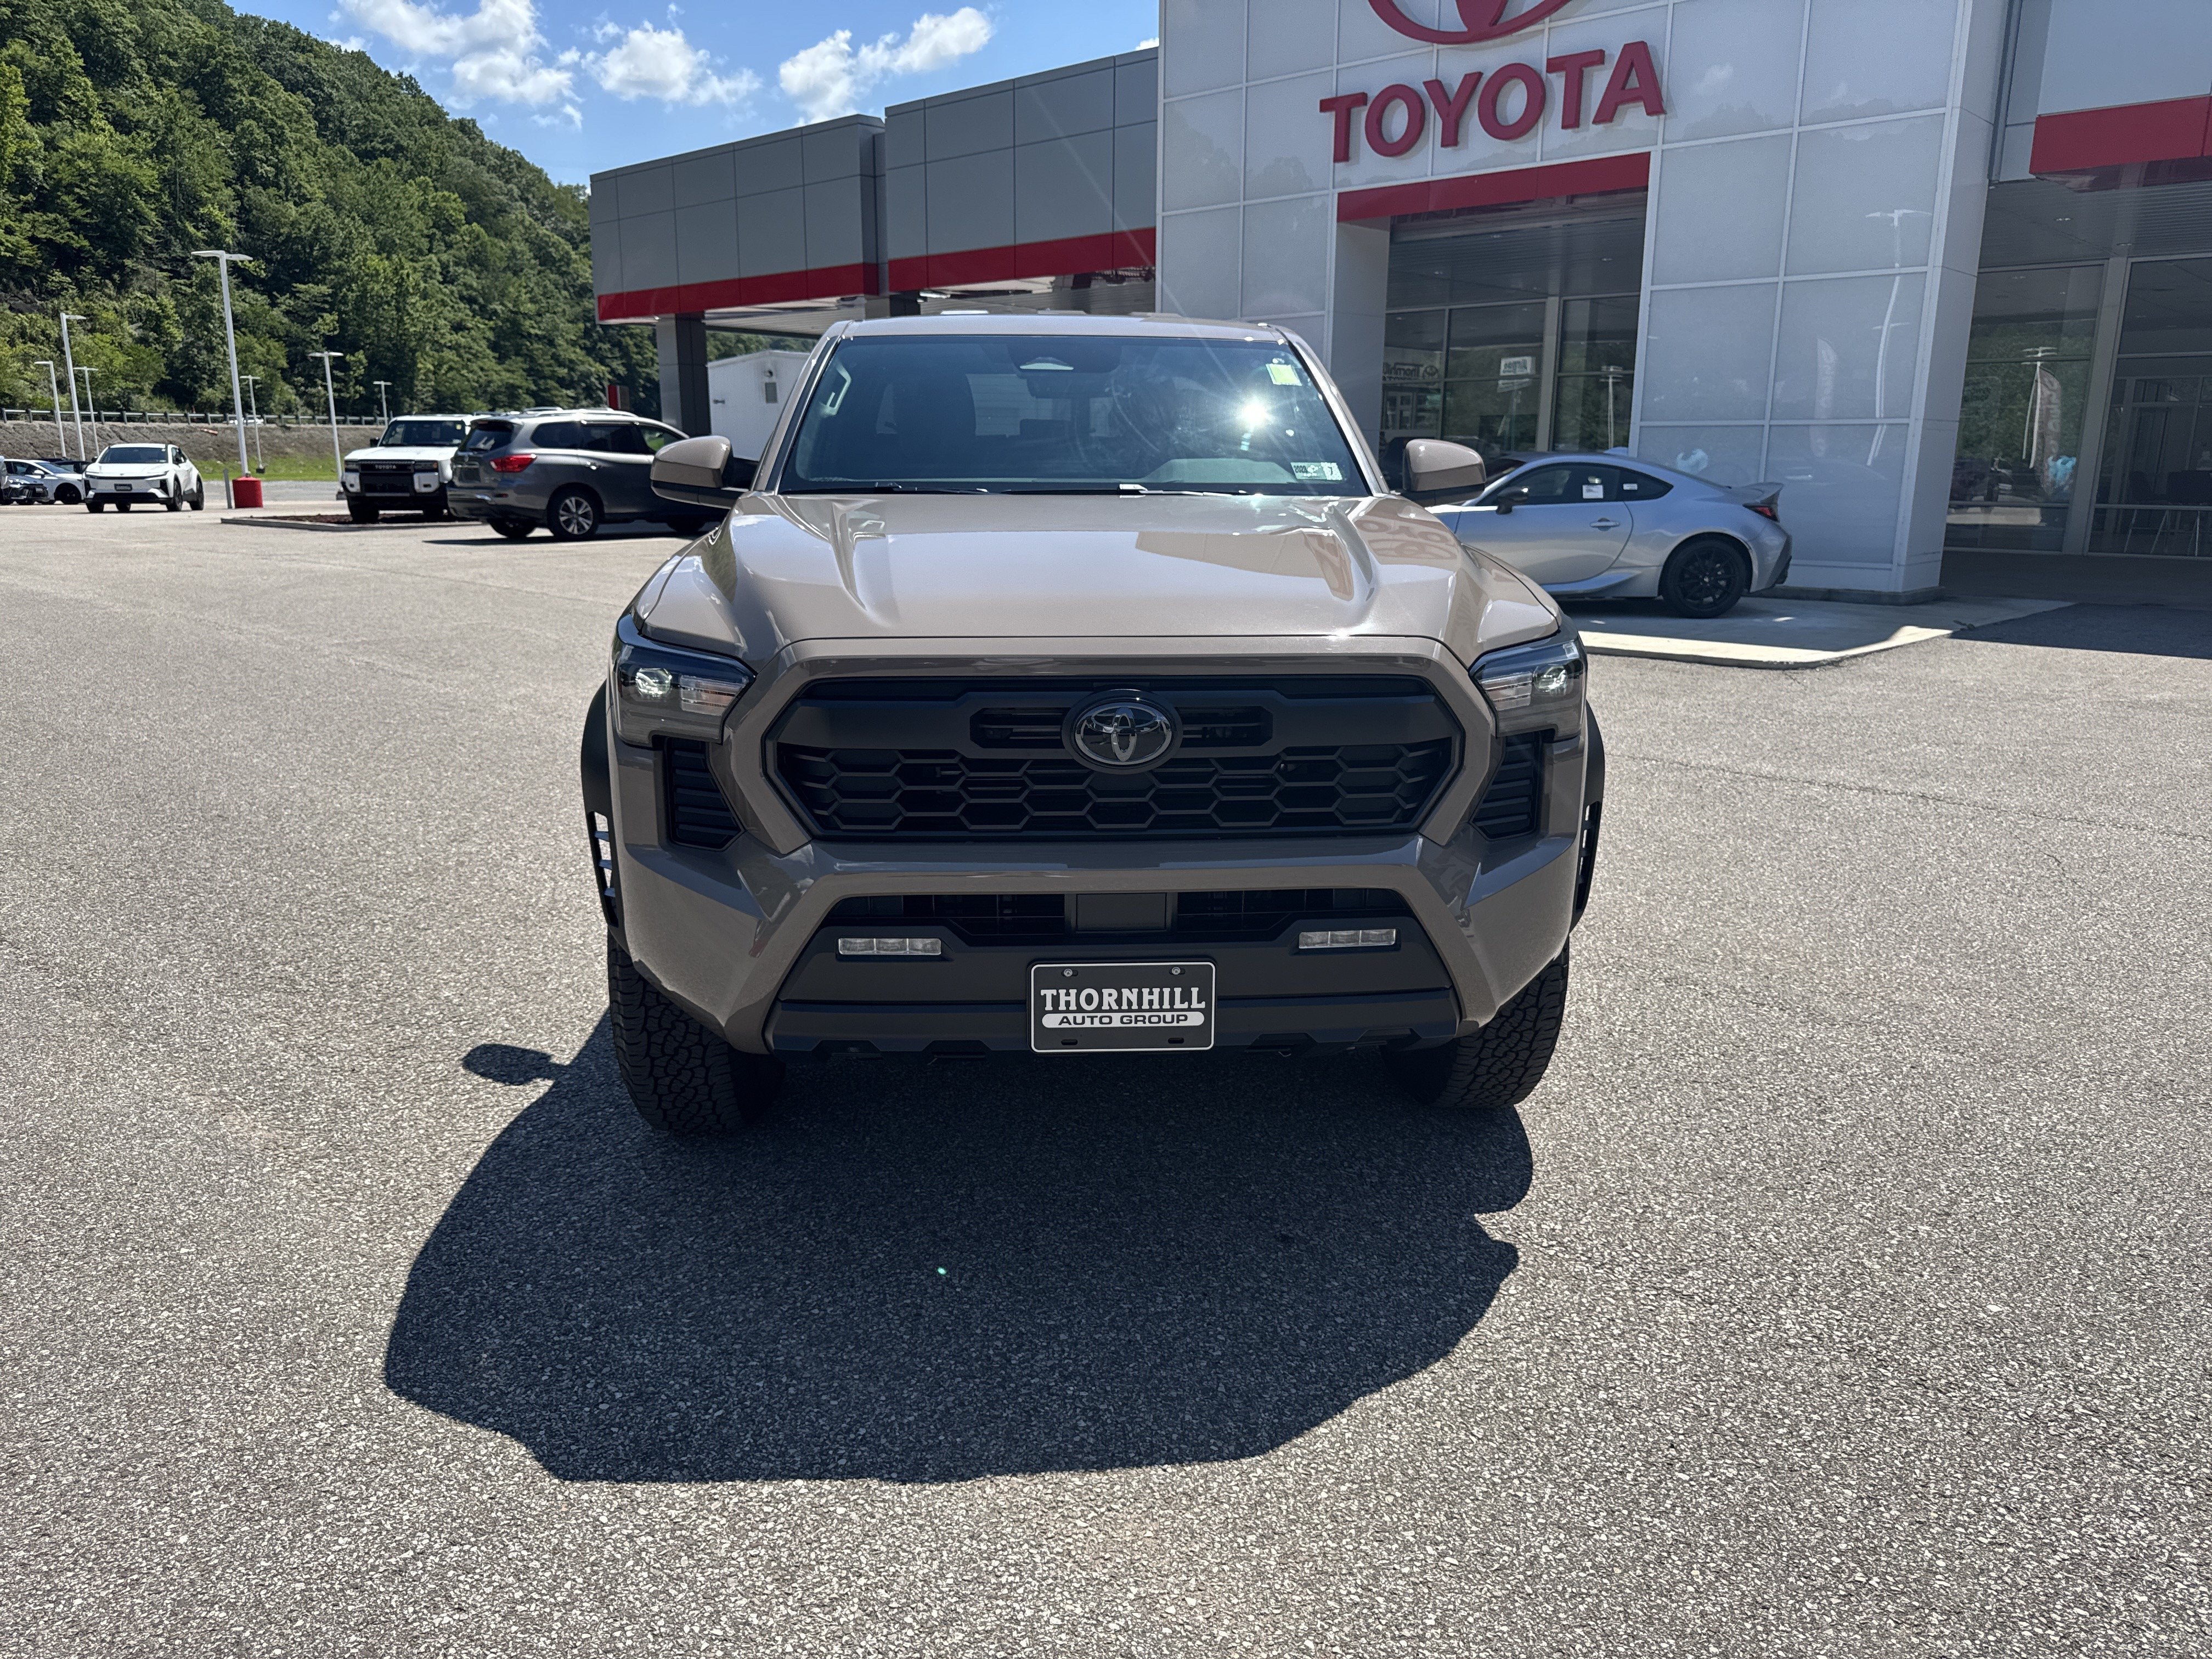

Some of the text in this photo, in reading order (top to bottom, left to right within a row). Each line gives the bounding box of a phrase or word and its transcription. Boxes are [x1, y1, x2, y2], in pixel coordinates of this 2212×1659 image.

[1320, 41, 1667, 162] TOYOTA
[1040, 988, 1206, 1011] THORNHILL
[1058, 1014, 1188, 1026] AUTO GROUP
